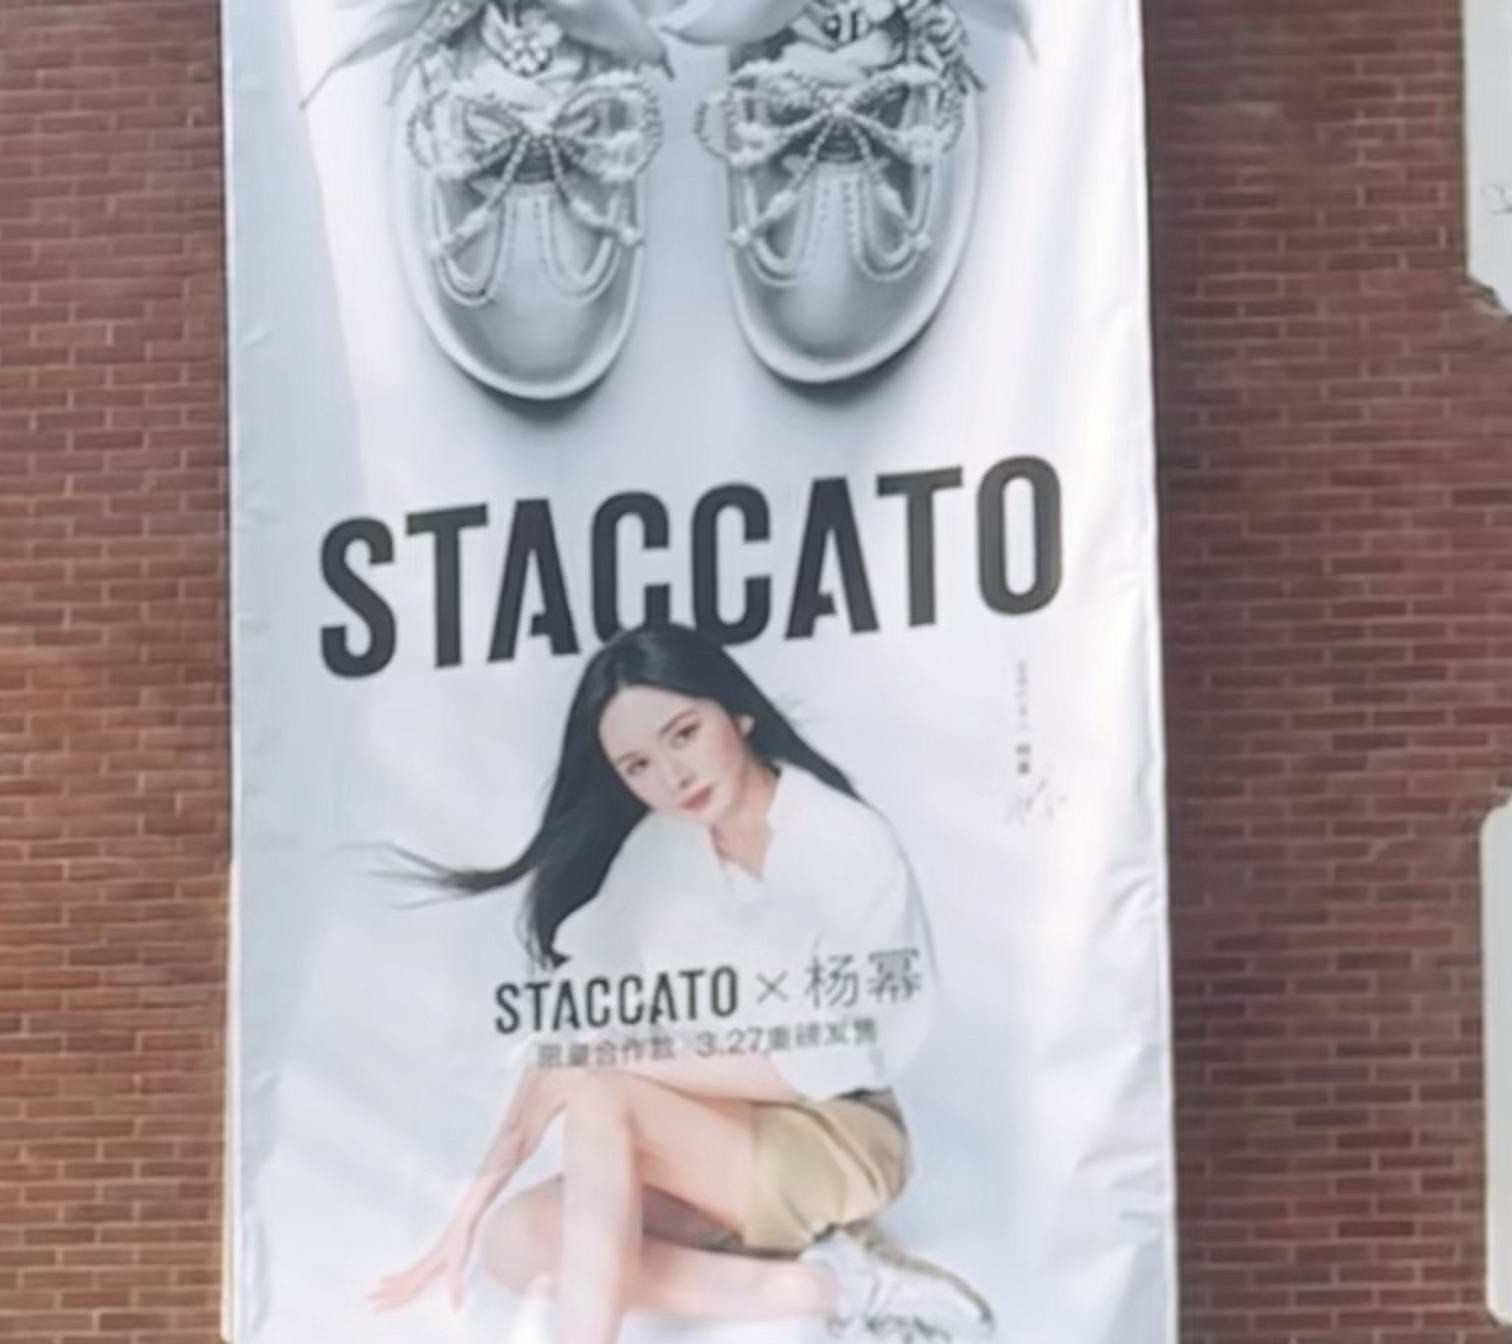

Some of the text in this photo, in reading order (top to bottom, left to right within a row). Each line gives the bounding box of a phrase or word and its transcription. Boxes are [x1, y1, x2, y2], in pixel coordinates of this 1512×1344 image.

[320, 455, 1063, 679] STACCATO
[495, 965, 738, 1036] STACCATO
[804, 948, 922, 1010] 杨幂
